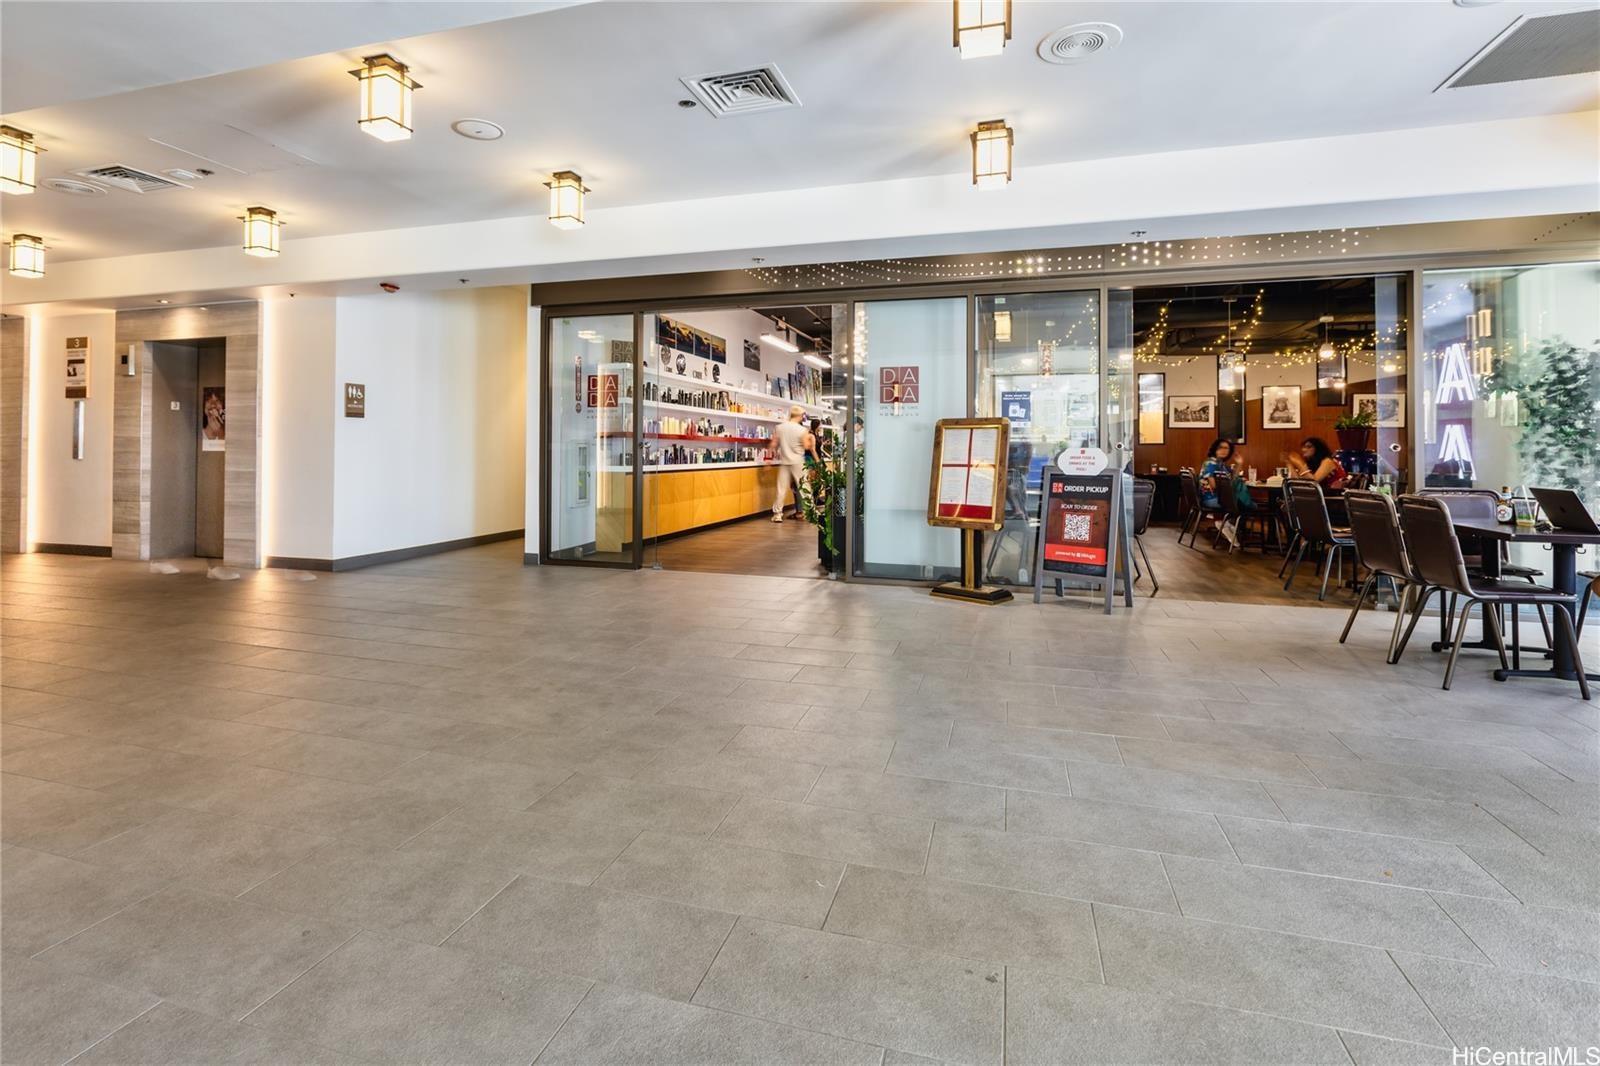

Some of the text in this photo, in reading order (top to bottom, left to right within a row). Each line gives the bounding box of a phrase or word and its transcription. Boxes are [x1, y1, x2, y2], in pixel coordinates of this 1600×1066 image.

[73, 338, 80, 348] 3
[1063, 485, 1109, 494] ORDER PICKUP
